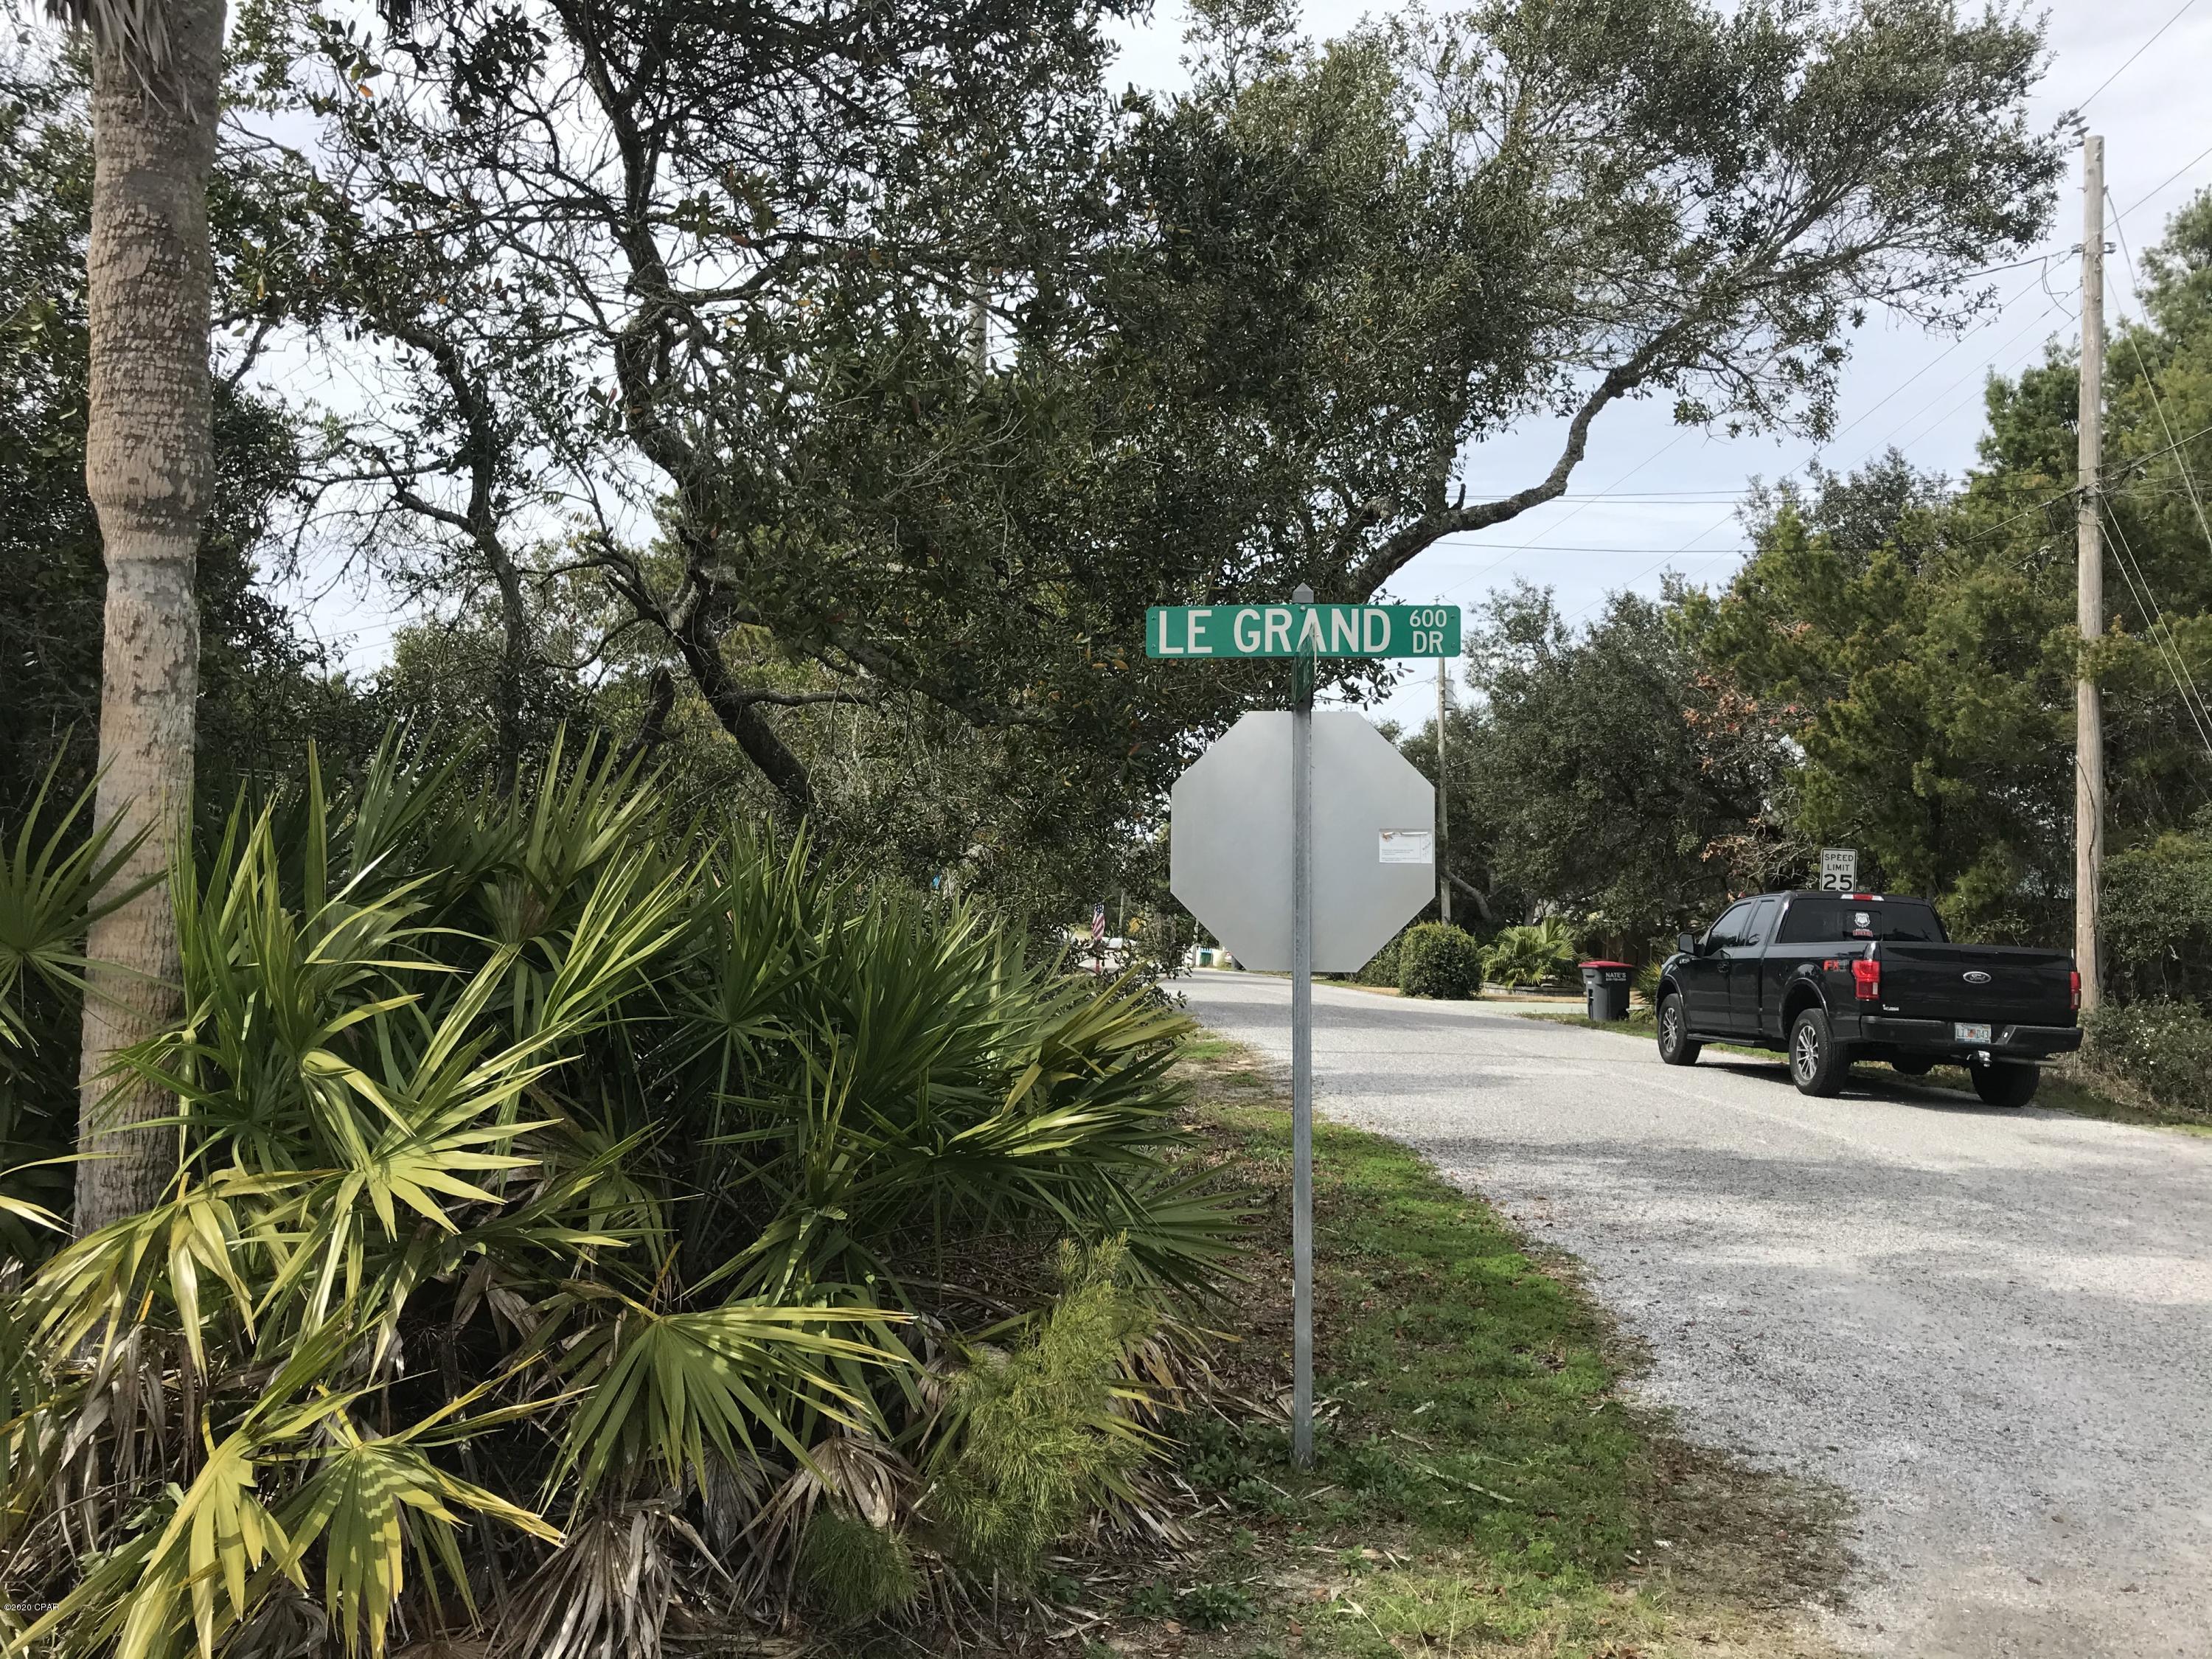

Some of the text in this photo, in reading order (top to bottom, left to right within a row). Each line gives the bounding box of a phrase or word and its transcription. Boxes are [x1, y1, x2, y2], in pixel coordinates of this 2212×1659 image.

[1409, 609, 1447, 627] 600
[1158, 608, 1391, 655] LE GRAND
[1412, 630, 1444, 654] DR
[1824, 853, 1854, 862] SPEED
[1826, 863, 1850, 872] LIMIT
[1823, 873, 1853, 891] 25
